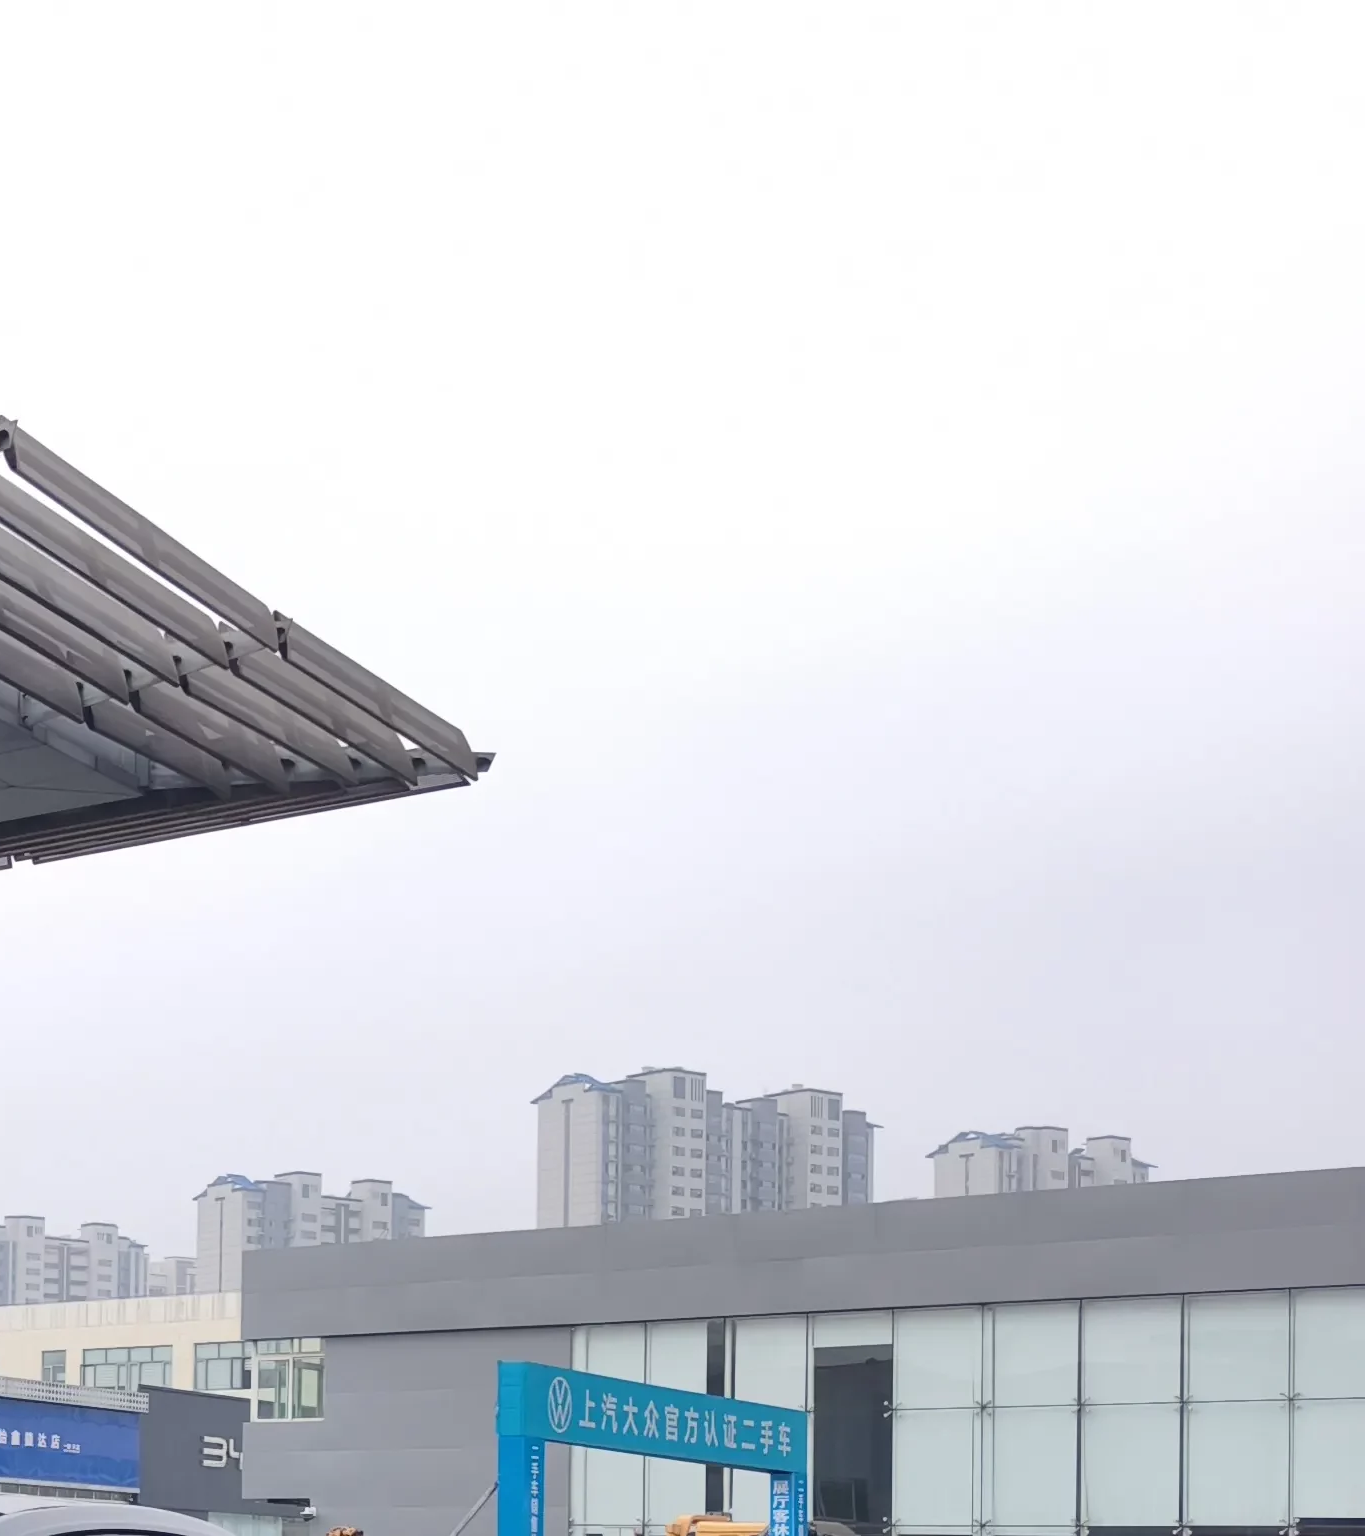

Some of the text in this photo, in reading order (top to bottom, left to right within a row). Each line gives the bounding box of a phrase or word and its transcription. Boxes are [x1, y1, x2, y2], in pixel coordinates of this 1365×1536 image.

[579, 1389, 791, 1457] 上汽大众官方认证二手车
